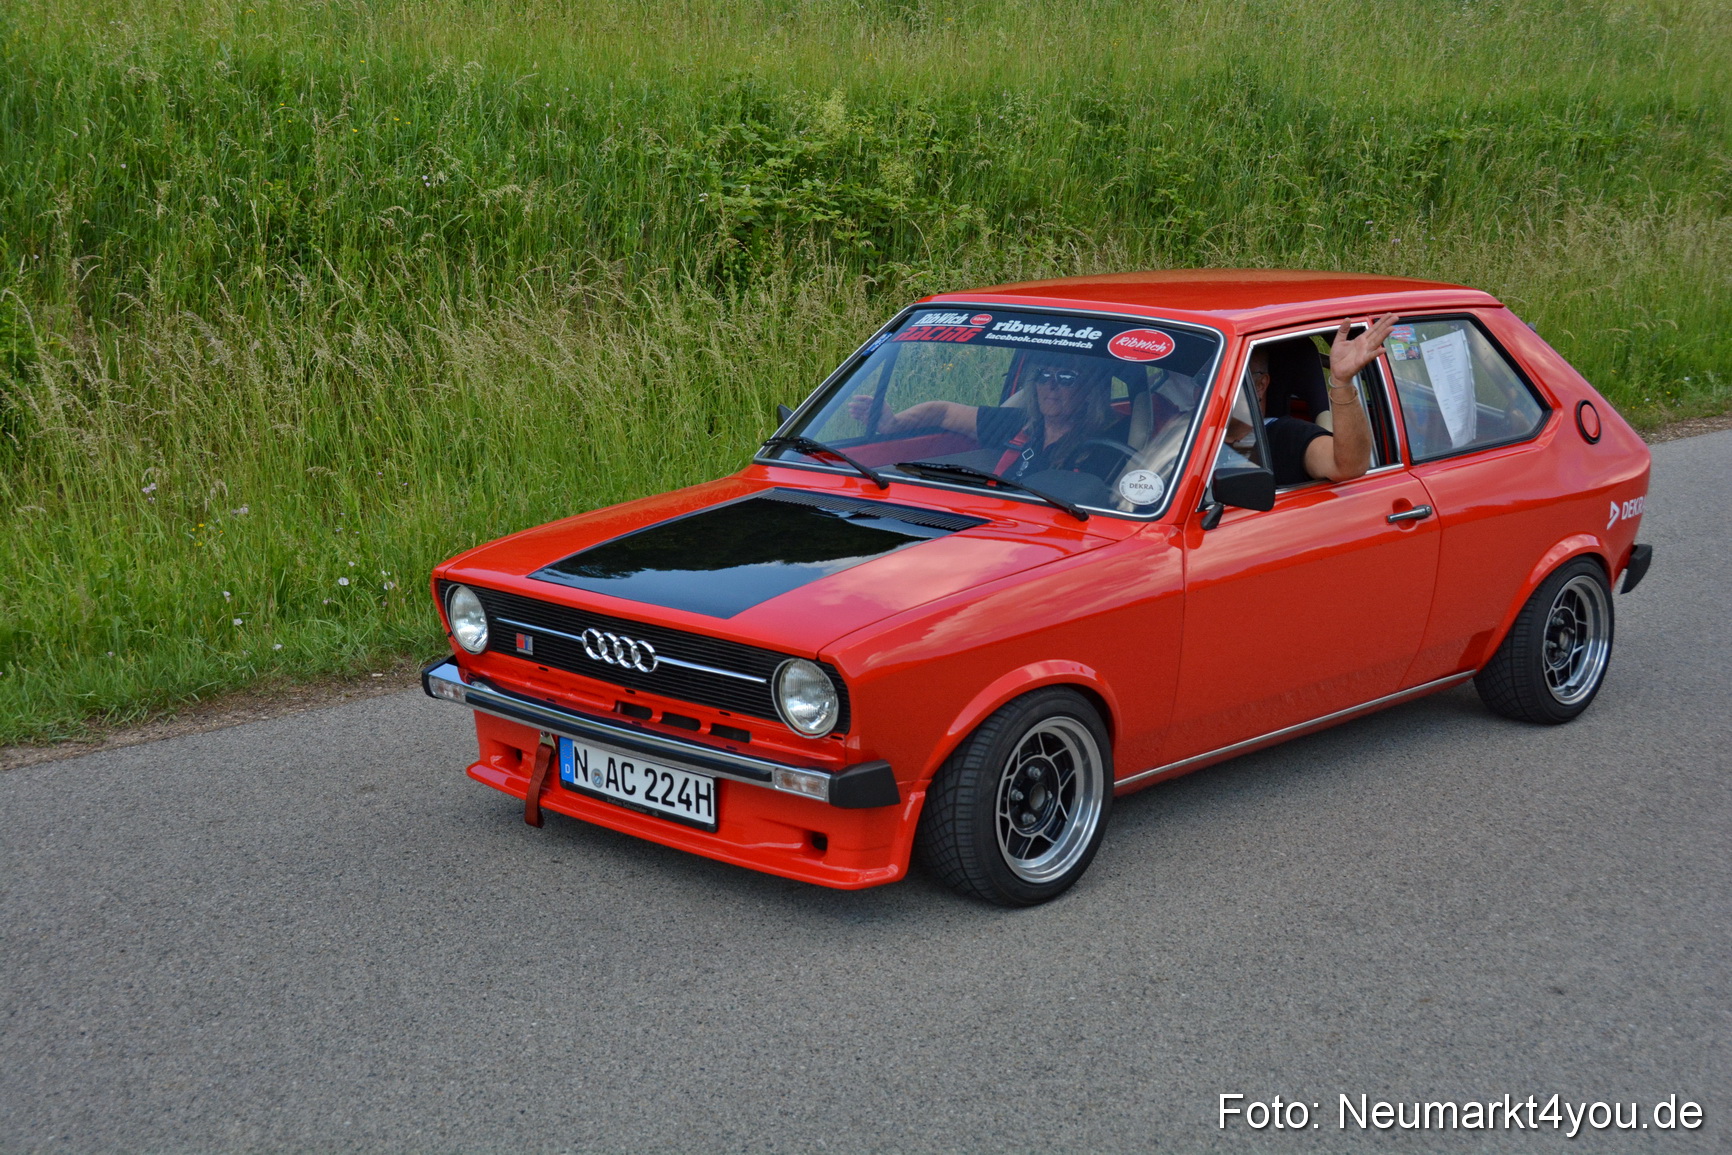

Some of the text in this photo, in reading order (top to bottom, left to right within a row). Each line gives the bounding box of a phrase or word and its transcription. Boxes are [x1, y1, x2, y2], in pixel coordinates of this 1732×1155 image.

[992, 320, 1103, 340] ribwich.de
[984, 333, 1094, 349] facebook.com/ribwich
[1129, 482, 1154, 491] DEKRA
[574, 746, 712, 817] N AC 224H
